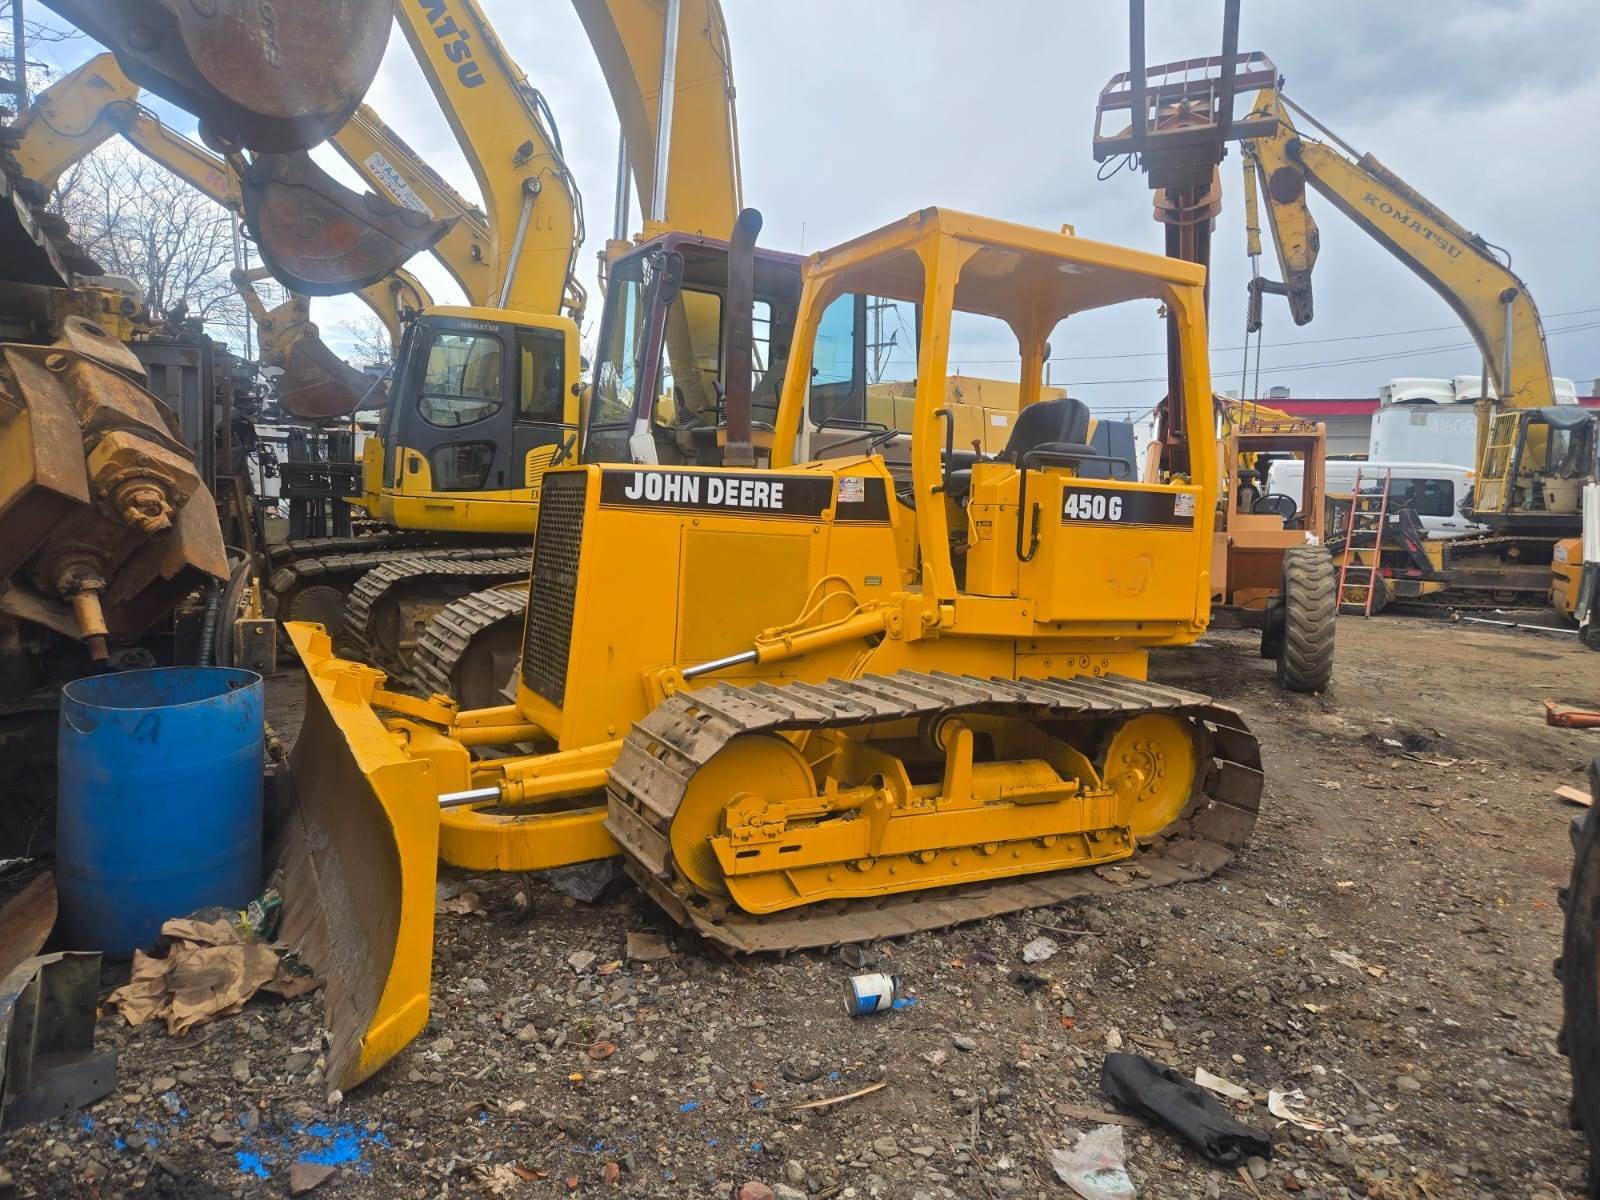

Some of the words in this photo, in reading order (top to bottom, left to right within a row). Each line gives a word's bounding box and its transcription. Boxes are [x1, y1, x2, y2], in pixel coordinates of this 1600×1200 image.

[1363, 192, 1462, 258] KOMATSU
[460, 320, 499, 332] KOMATSU
[625, 472, 699, 503] JOHN
[707, 478, 784, 509] DEERE
